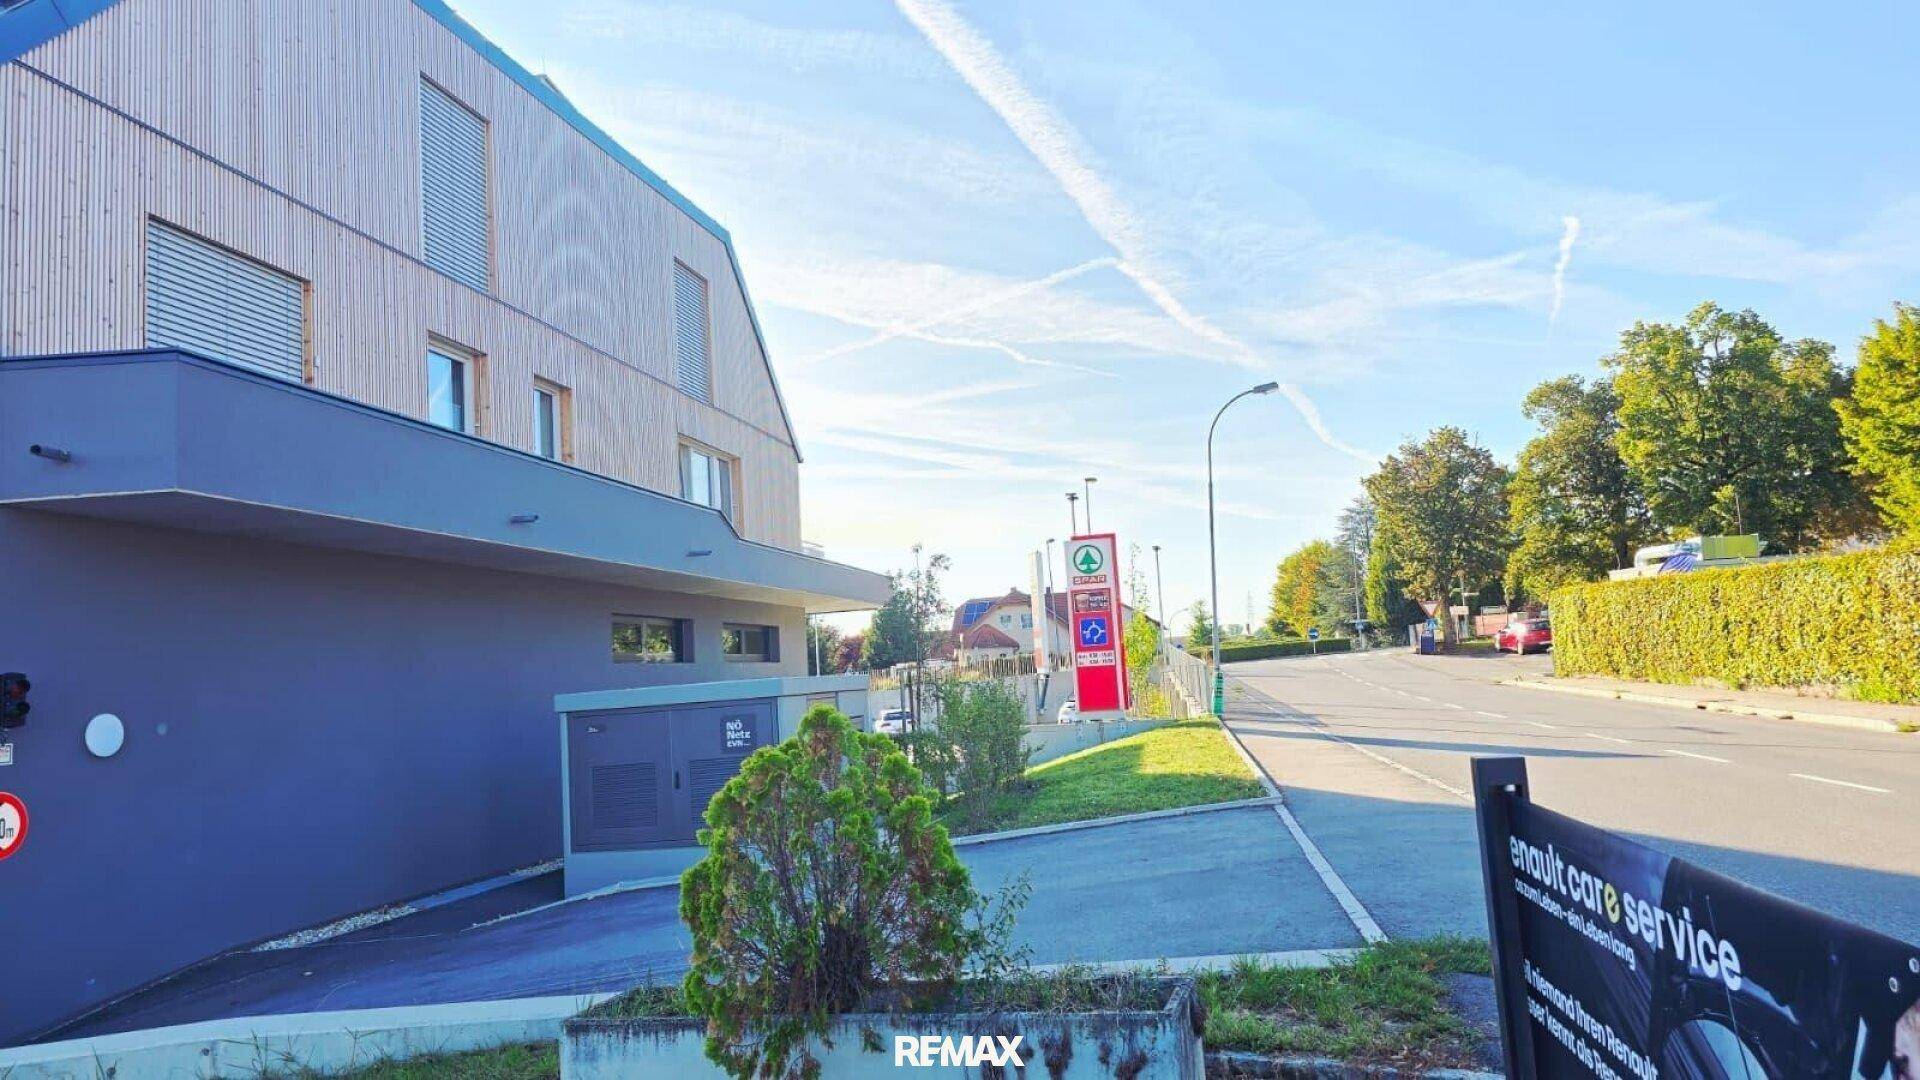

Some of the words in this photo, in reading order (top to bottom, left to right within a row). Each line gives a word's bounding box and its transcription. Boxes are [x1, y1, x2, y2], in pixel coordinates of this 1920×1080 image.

[1073, 575, 1106, 584] SPAR
[726, 719, 743, 731] NÖ
[726, 730, 751, 739] Netz
[1509, 834, 1567, 895] enault
[1566, 864, 1621, 924] care
[1622, 892, 1741, 991] service
[1537, 888, 1563, 919] Leben
[1580, 914, 1611, 949] Leben
[1609, 931, 1636, 971] lang
[1531, 966, 1575, 1021] niemand
[1574, 999, 1607, 1047] Ihren
[1576, 1037, 1595, 1070] als
